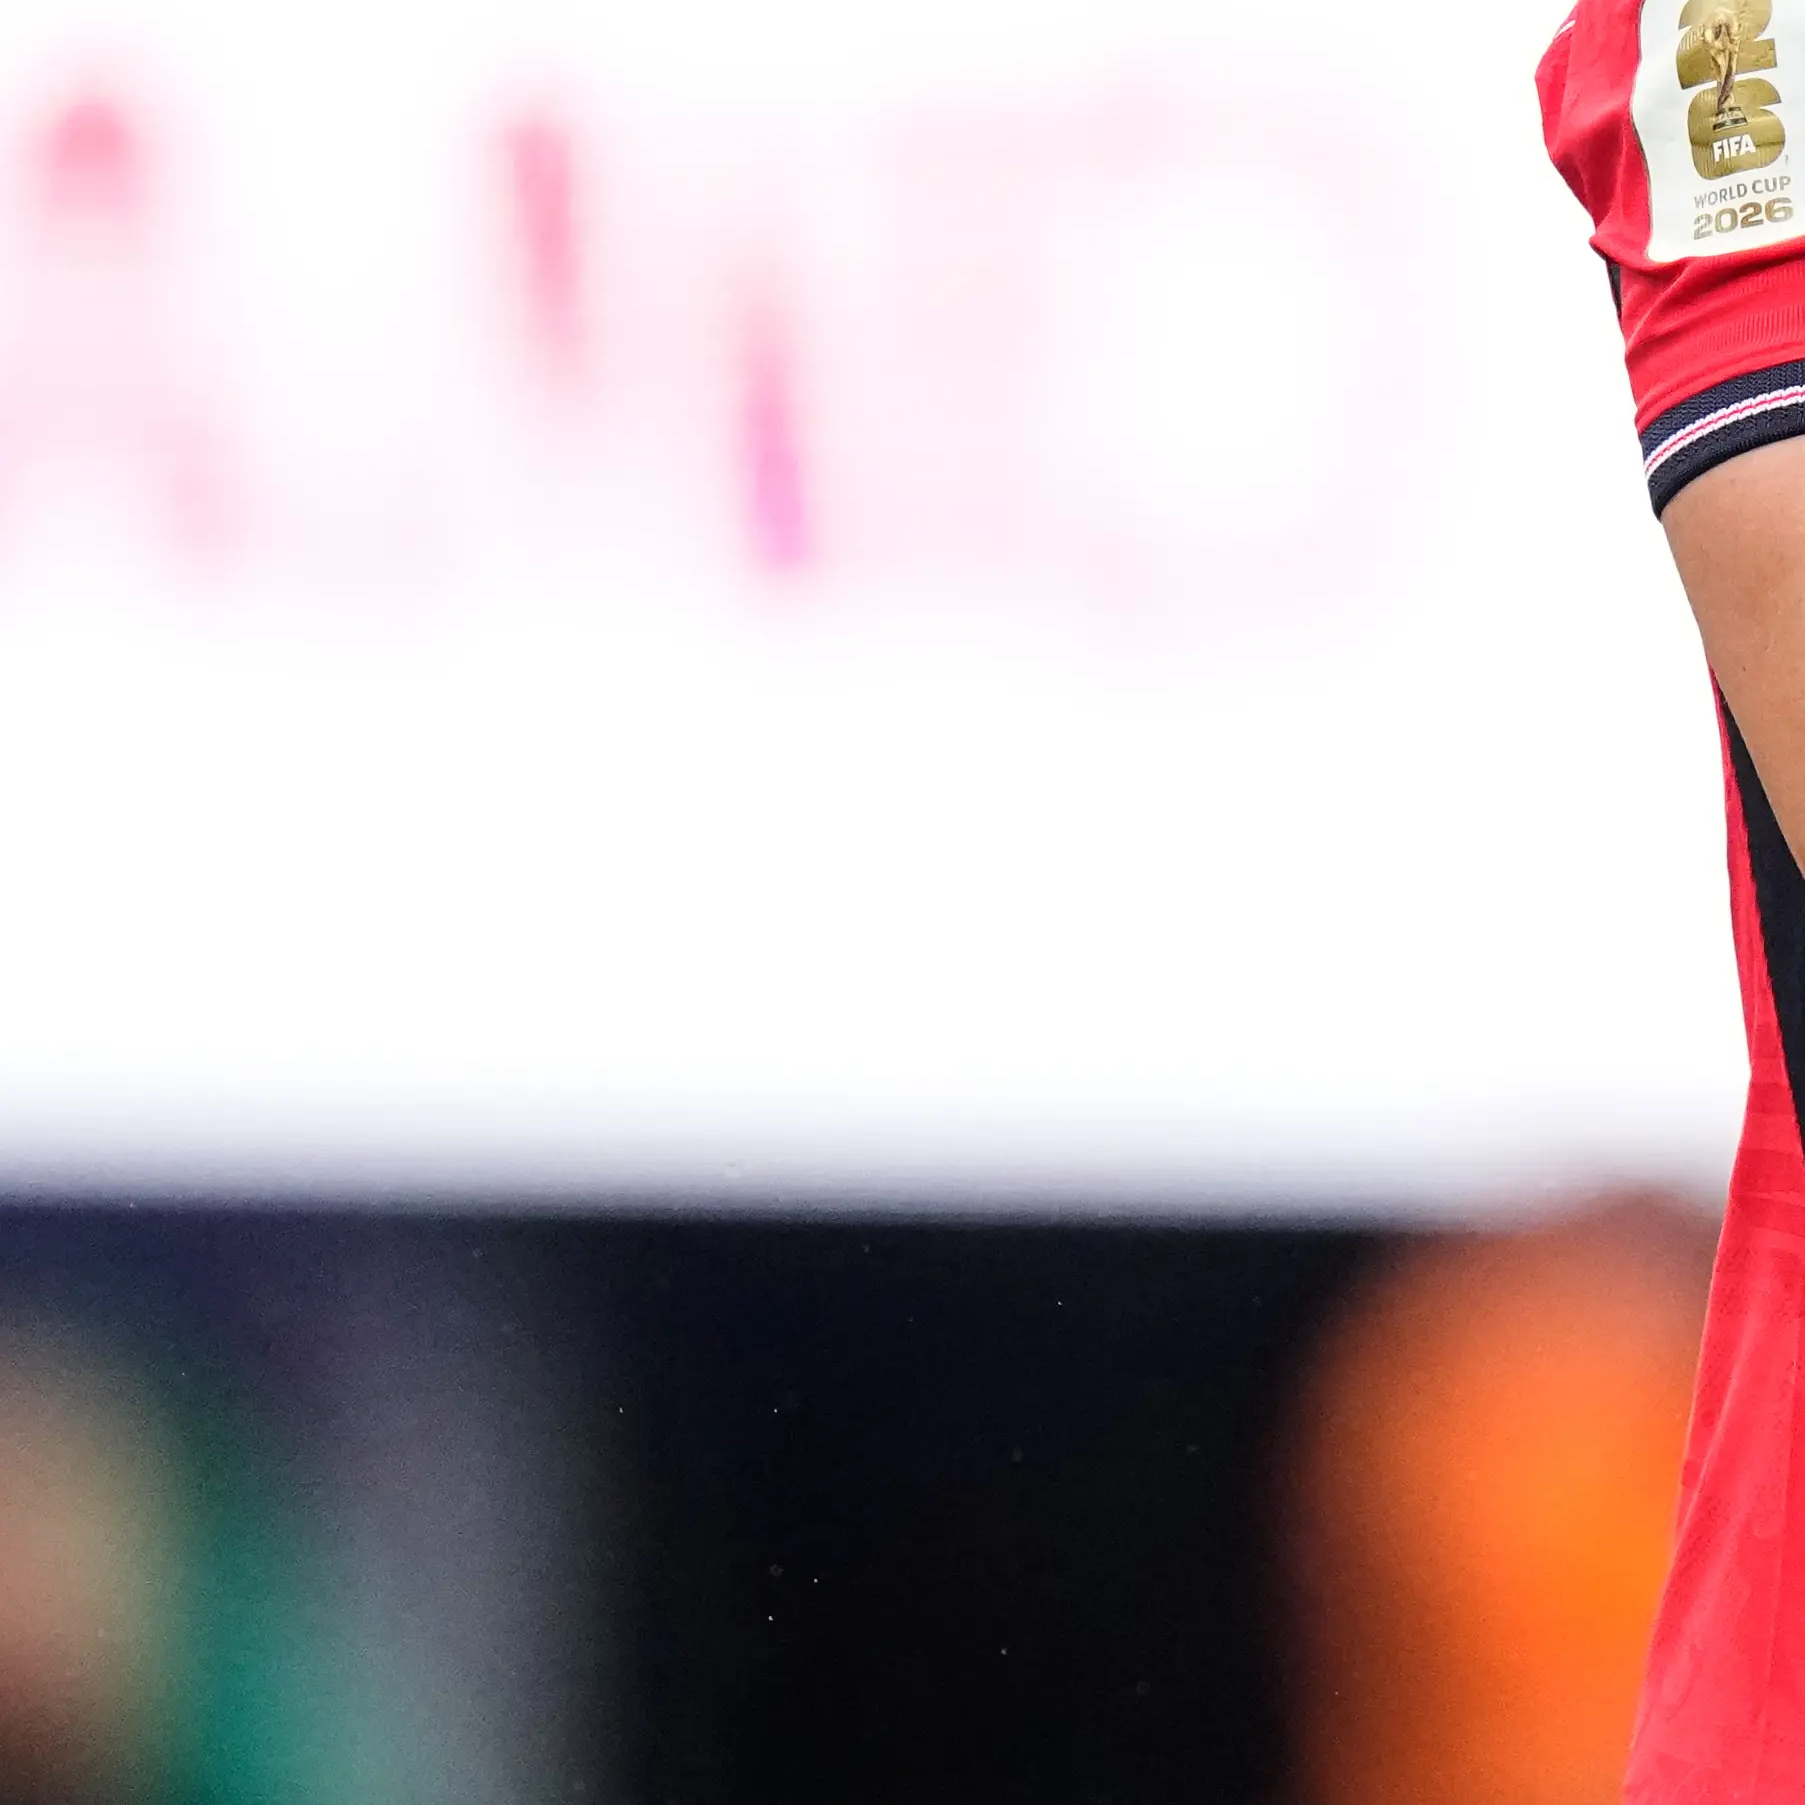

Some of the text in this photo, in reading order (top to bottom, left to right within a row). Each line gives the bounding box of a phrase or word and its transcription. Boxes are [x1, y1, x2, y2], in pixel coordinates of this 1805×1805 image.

[1713, 134, 1757, 163] FIFA
[1693, 175, 1792, 209] WORLD CUP
[1693, 196, 1794, 241] 2026
